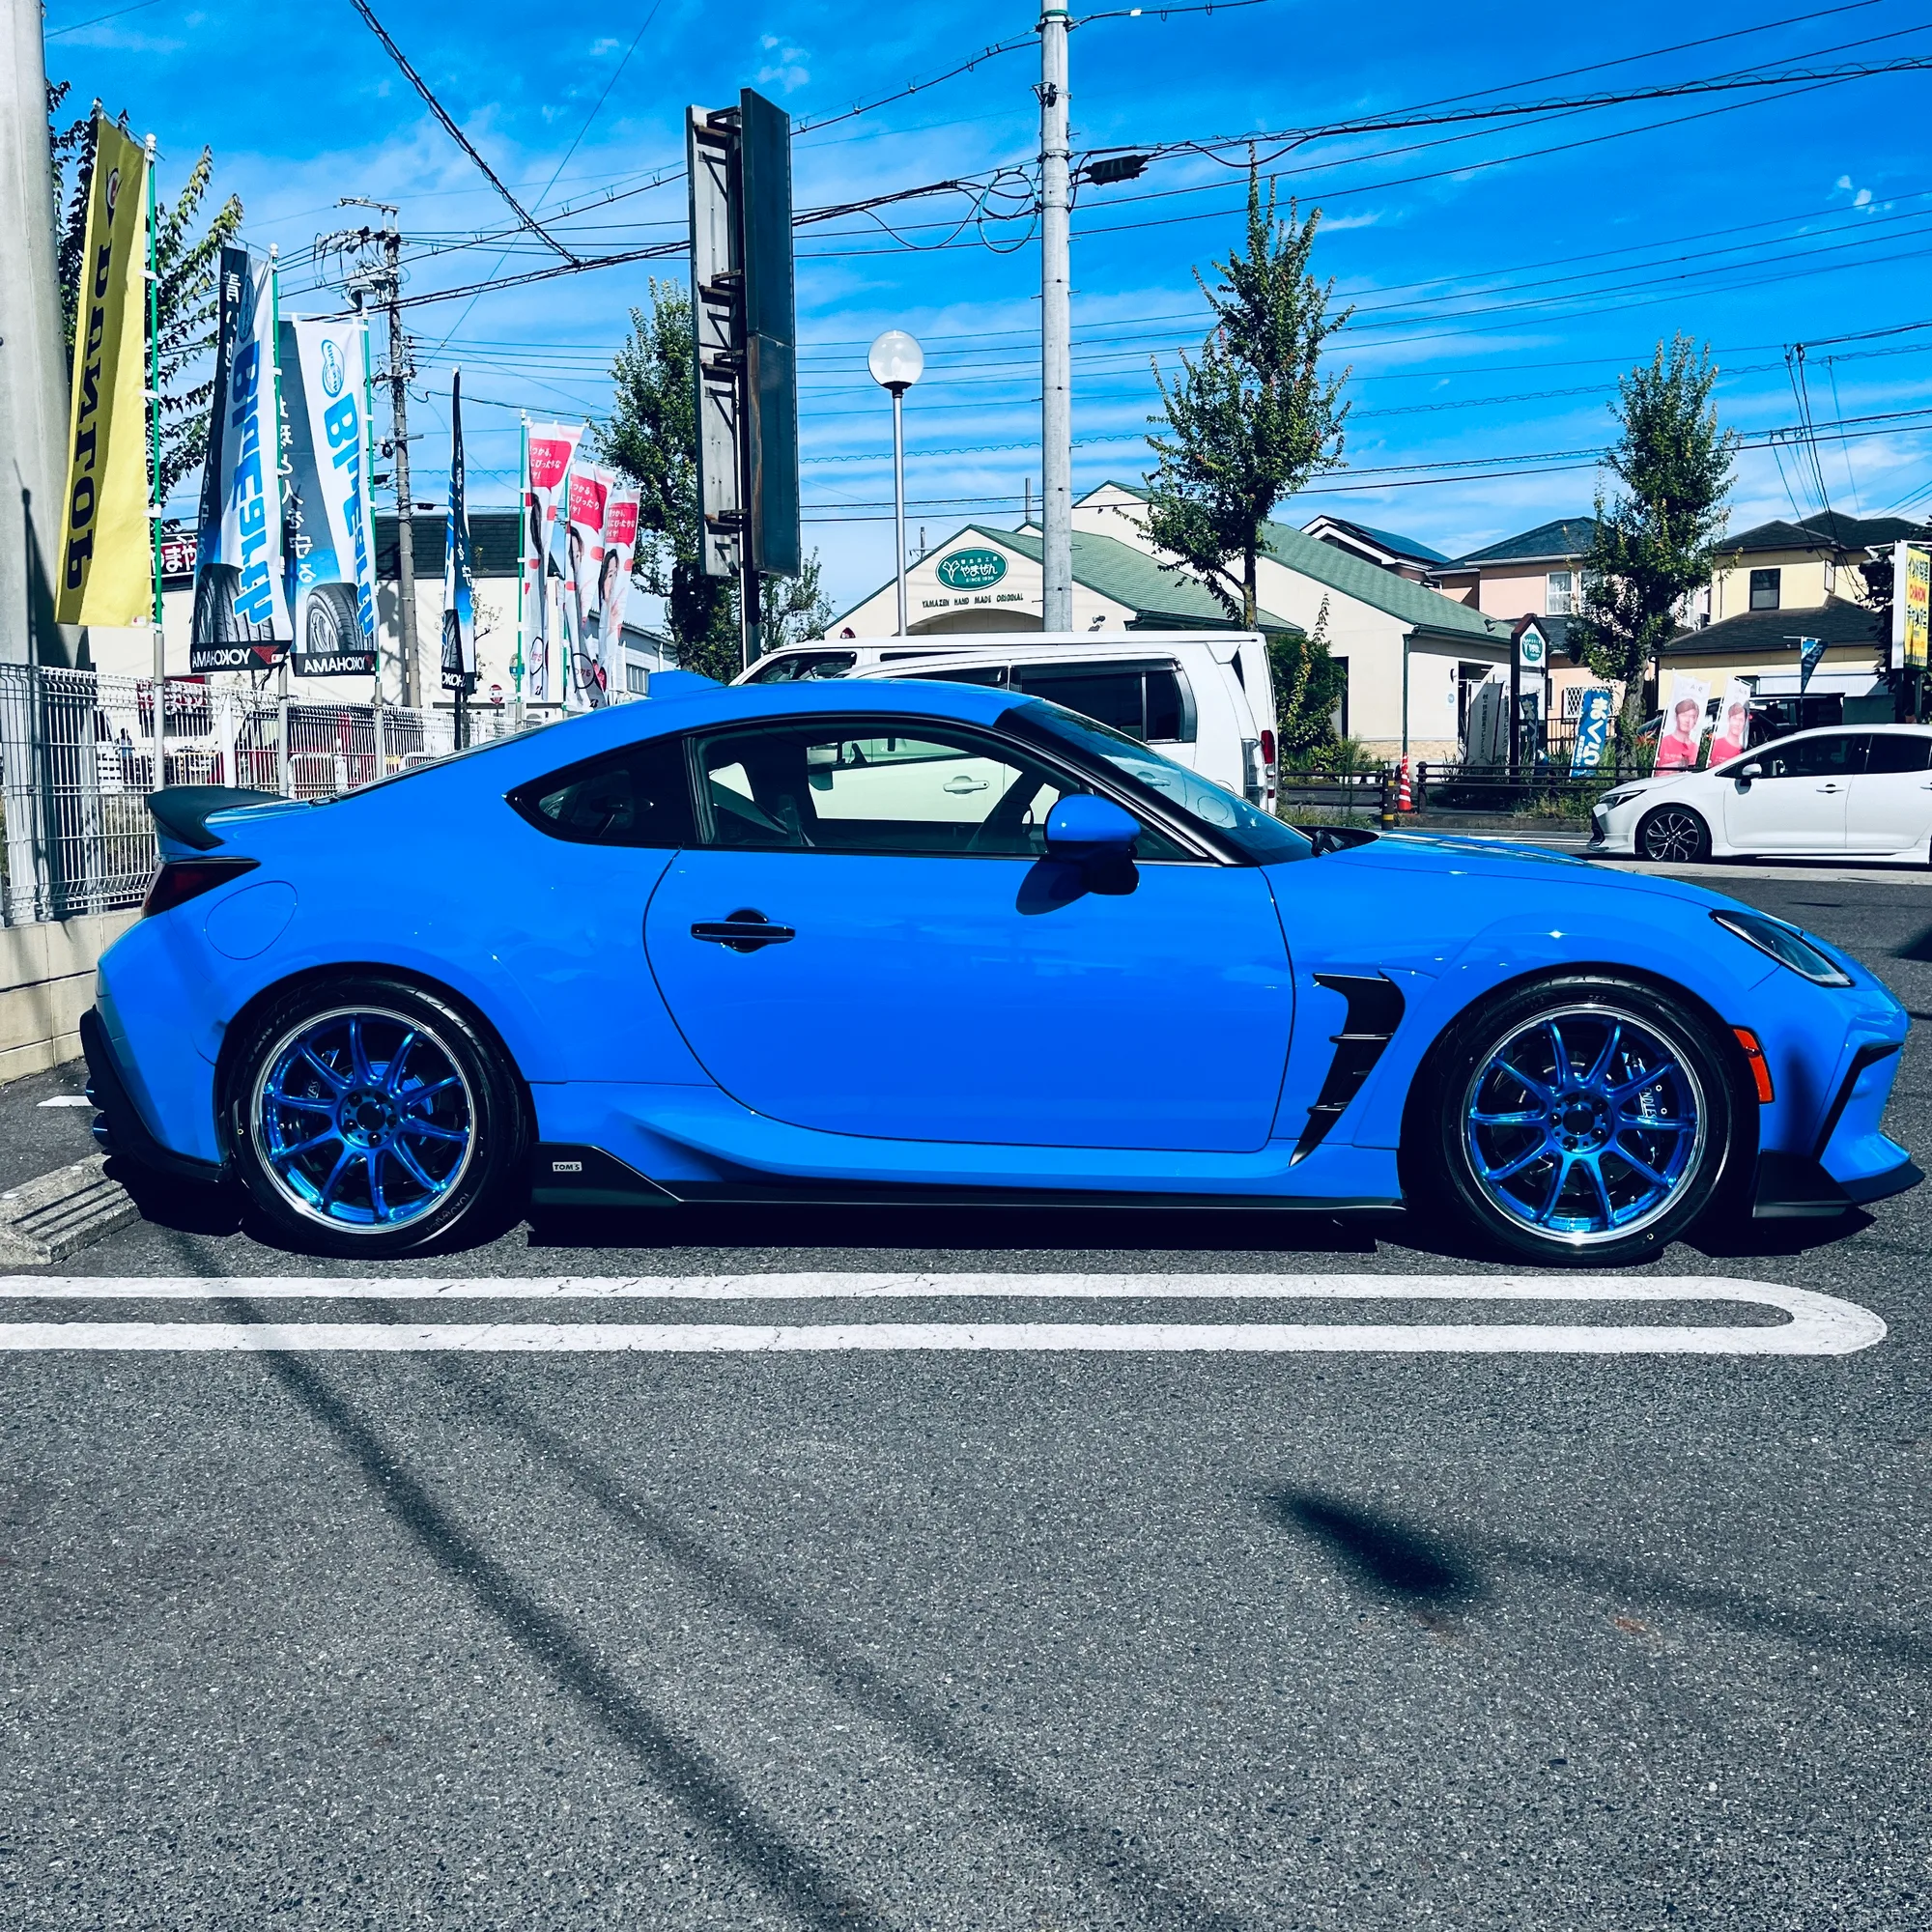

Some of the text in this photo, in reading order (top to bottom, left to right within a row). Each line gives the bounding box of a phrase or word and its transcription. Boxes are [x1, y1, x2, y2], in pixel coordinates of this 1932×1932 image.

[960, 563, 999, 578] やまぜん
[922, 593, 1024, 608] YAMAZEN HAND MADE ORIGINAL
[1582, 696, 1609, 766] まくら
